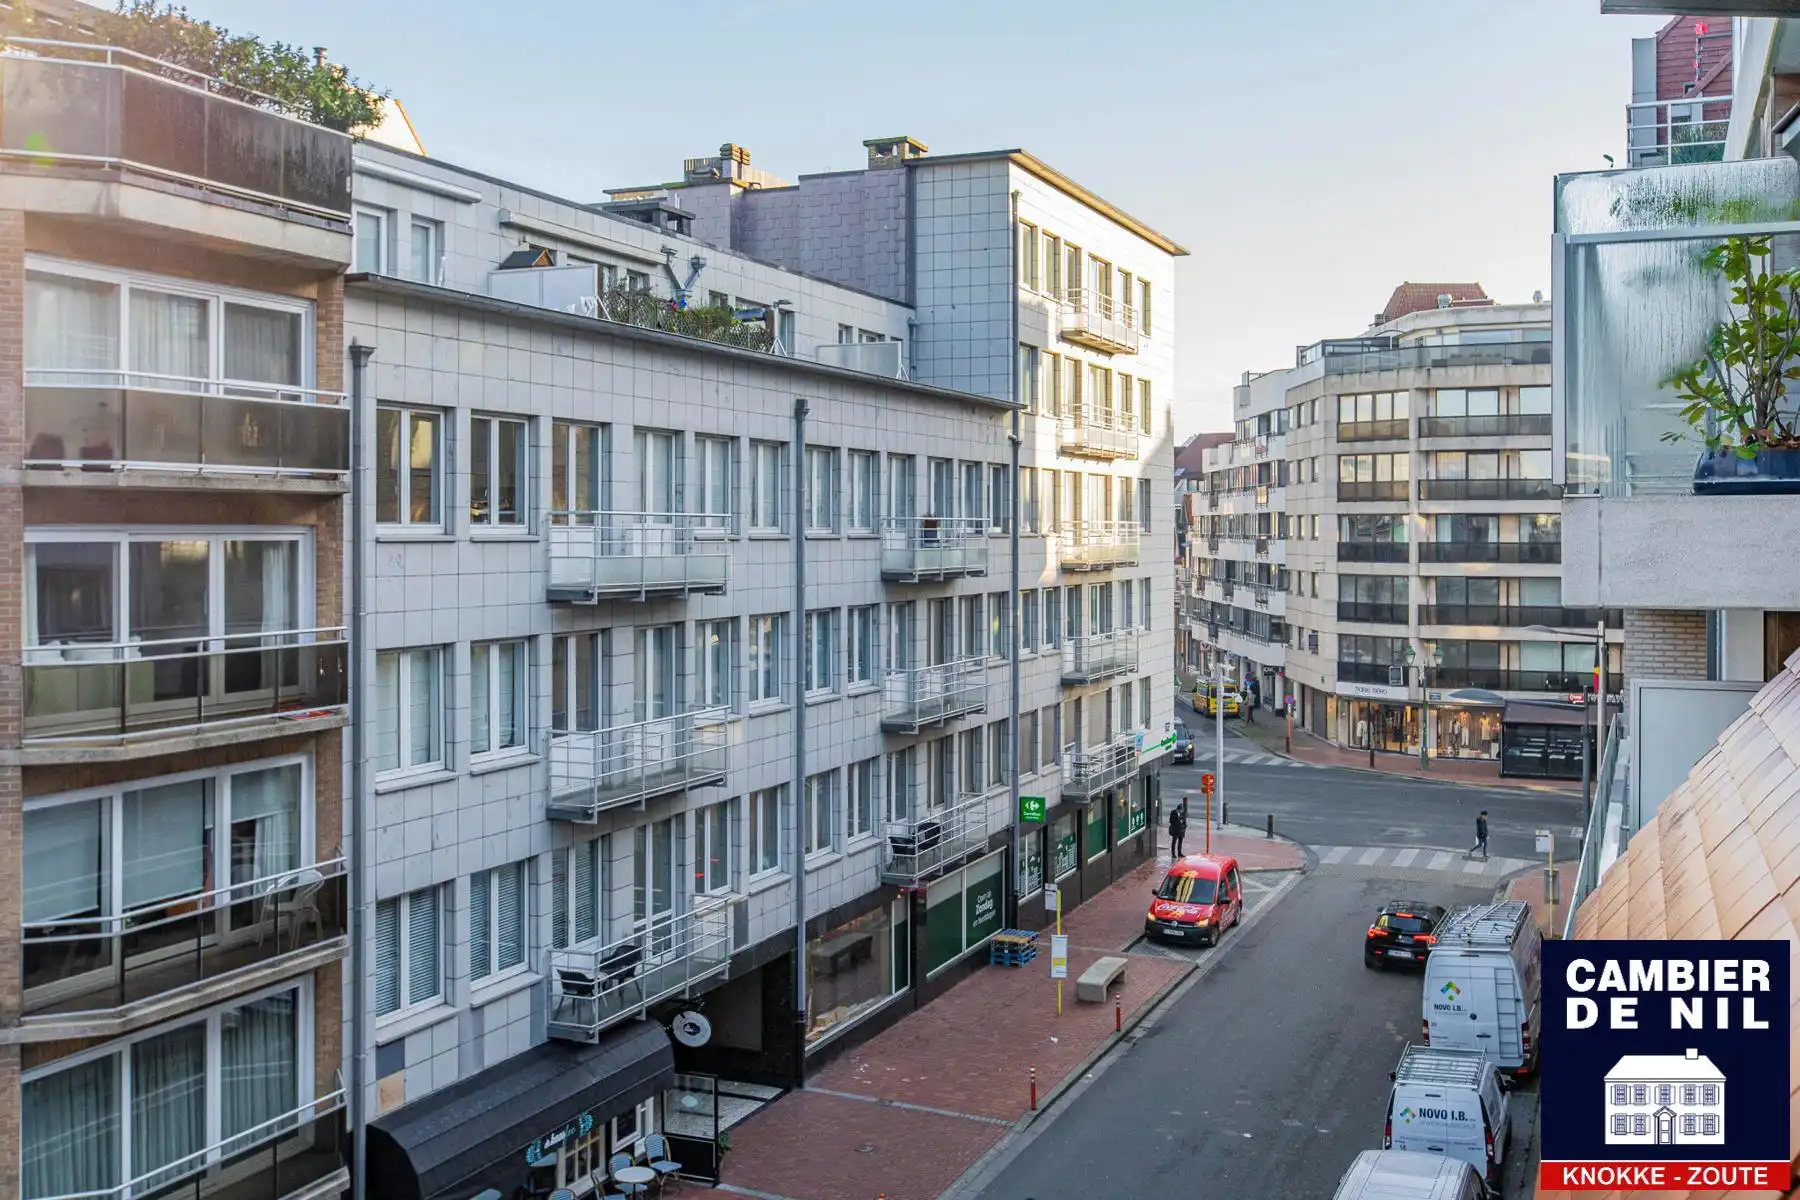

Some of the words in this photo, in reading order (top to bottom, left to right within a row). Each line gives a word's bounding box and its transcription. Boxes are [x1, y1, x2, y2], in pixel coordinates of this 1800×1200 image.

[975, 899, 994, 915] Zondag
[1433, 1003, 1451, 1011] NOVO
[1418, 1107, 1447, 1120] NOVO
[1451, 1110, 1468, 1122] I.B.
